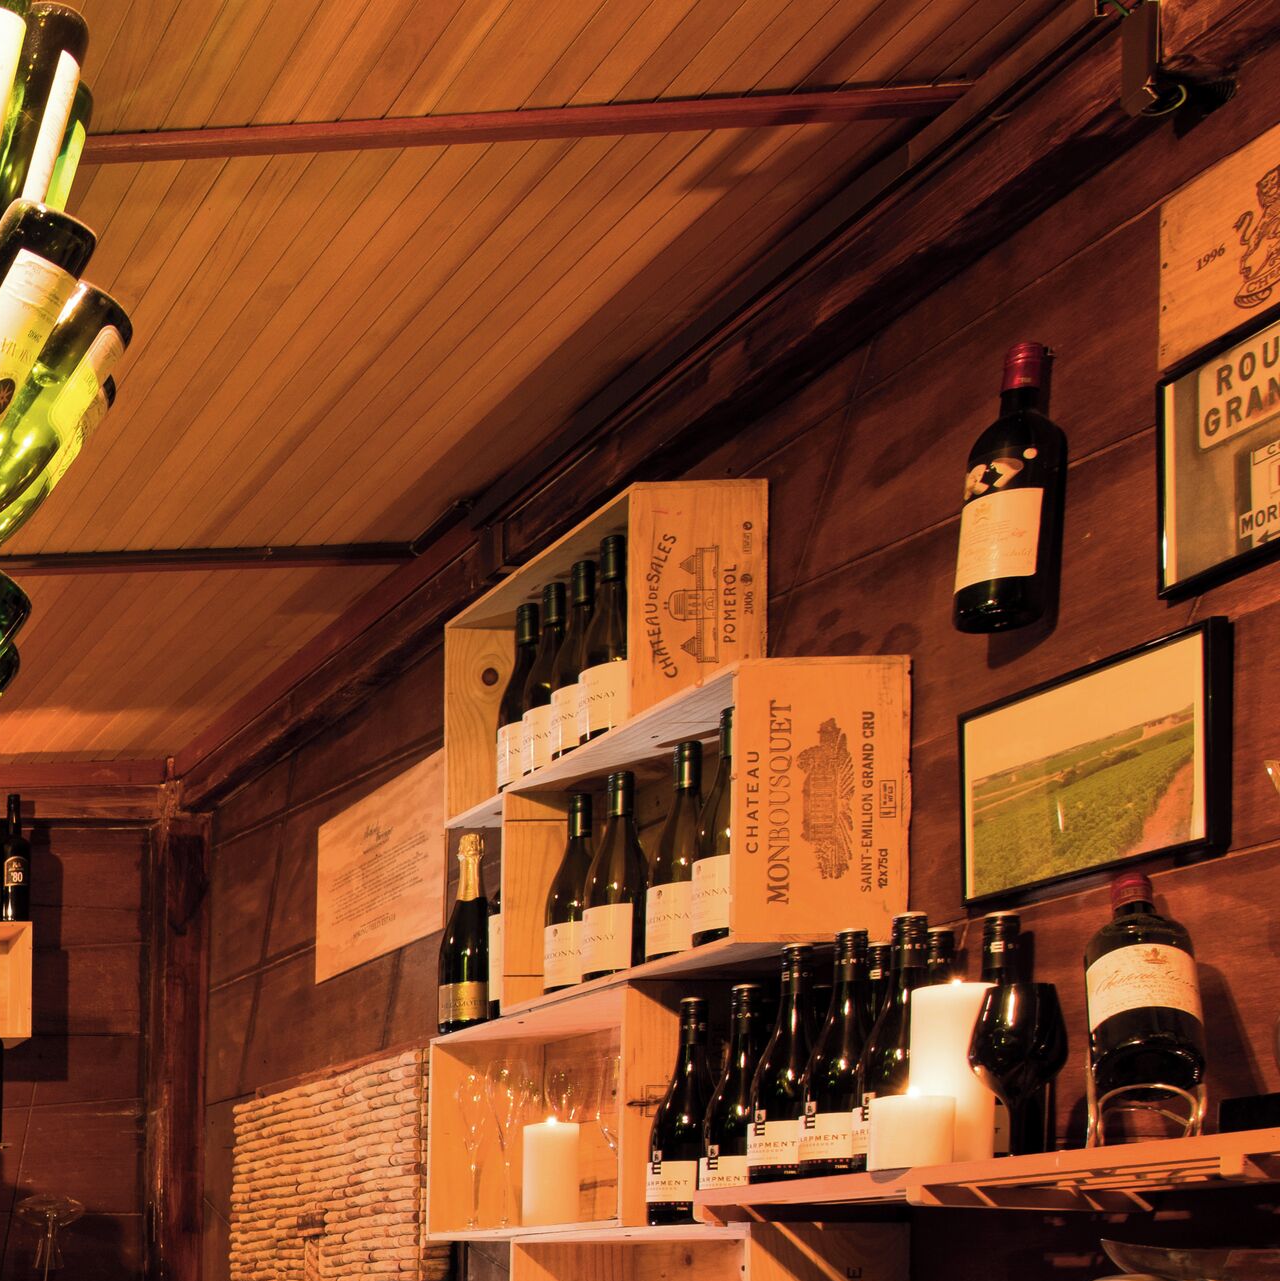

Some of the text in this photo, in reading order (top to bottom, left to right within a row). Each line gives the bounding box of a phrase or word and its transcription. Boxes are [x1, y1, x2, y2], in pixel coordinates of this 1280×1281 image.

[1196, 243, 1226, 272] 1996
[650, 533, 678, 582] SALES
[646, 597, 679, 680] CHATEAU
[723, 563, 738, 644] POMEROL
[744, 590, 754, 616] 2006
[745, 750, 761, 854] CHATEAU
[767, 699, 793, 905] MONBOUSQUET
[861, 710, 875, 893] SAINT-EMILION GRAND CRU
